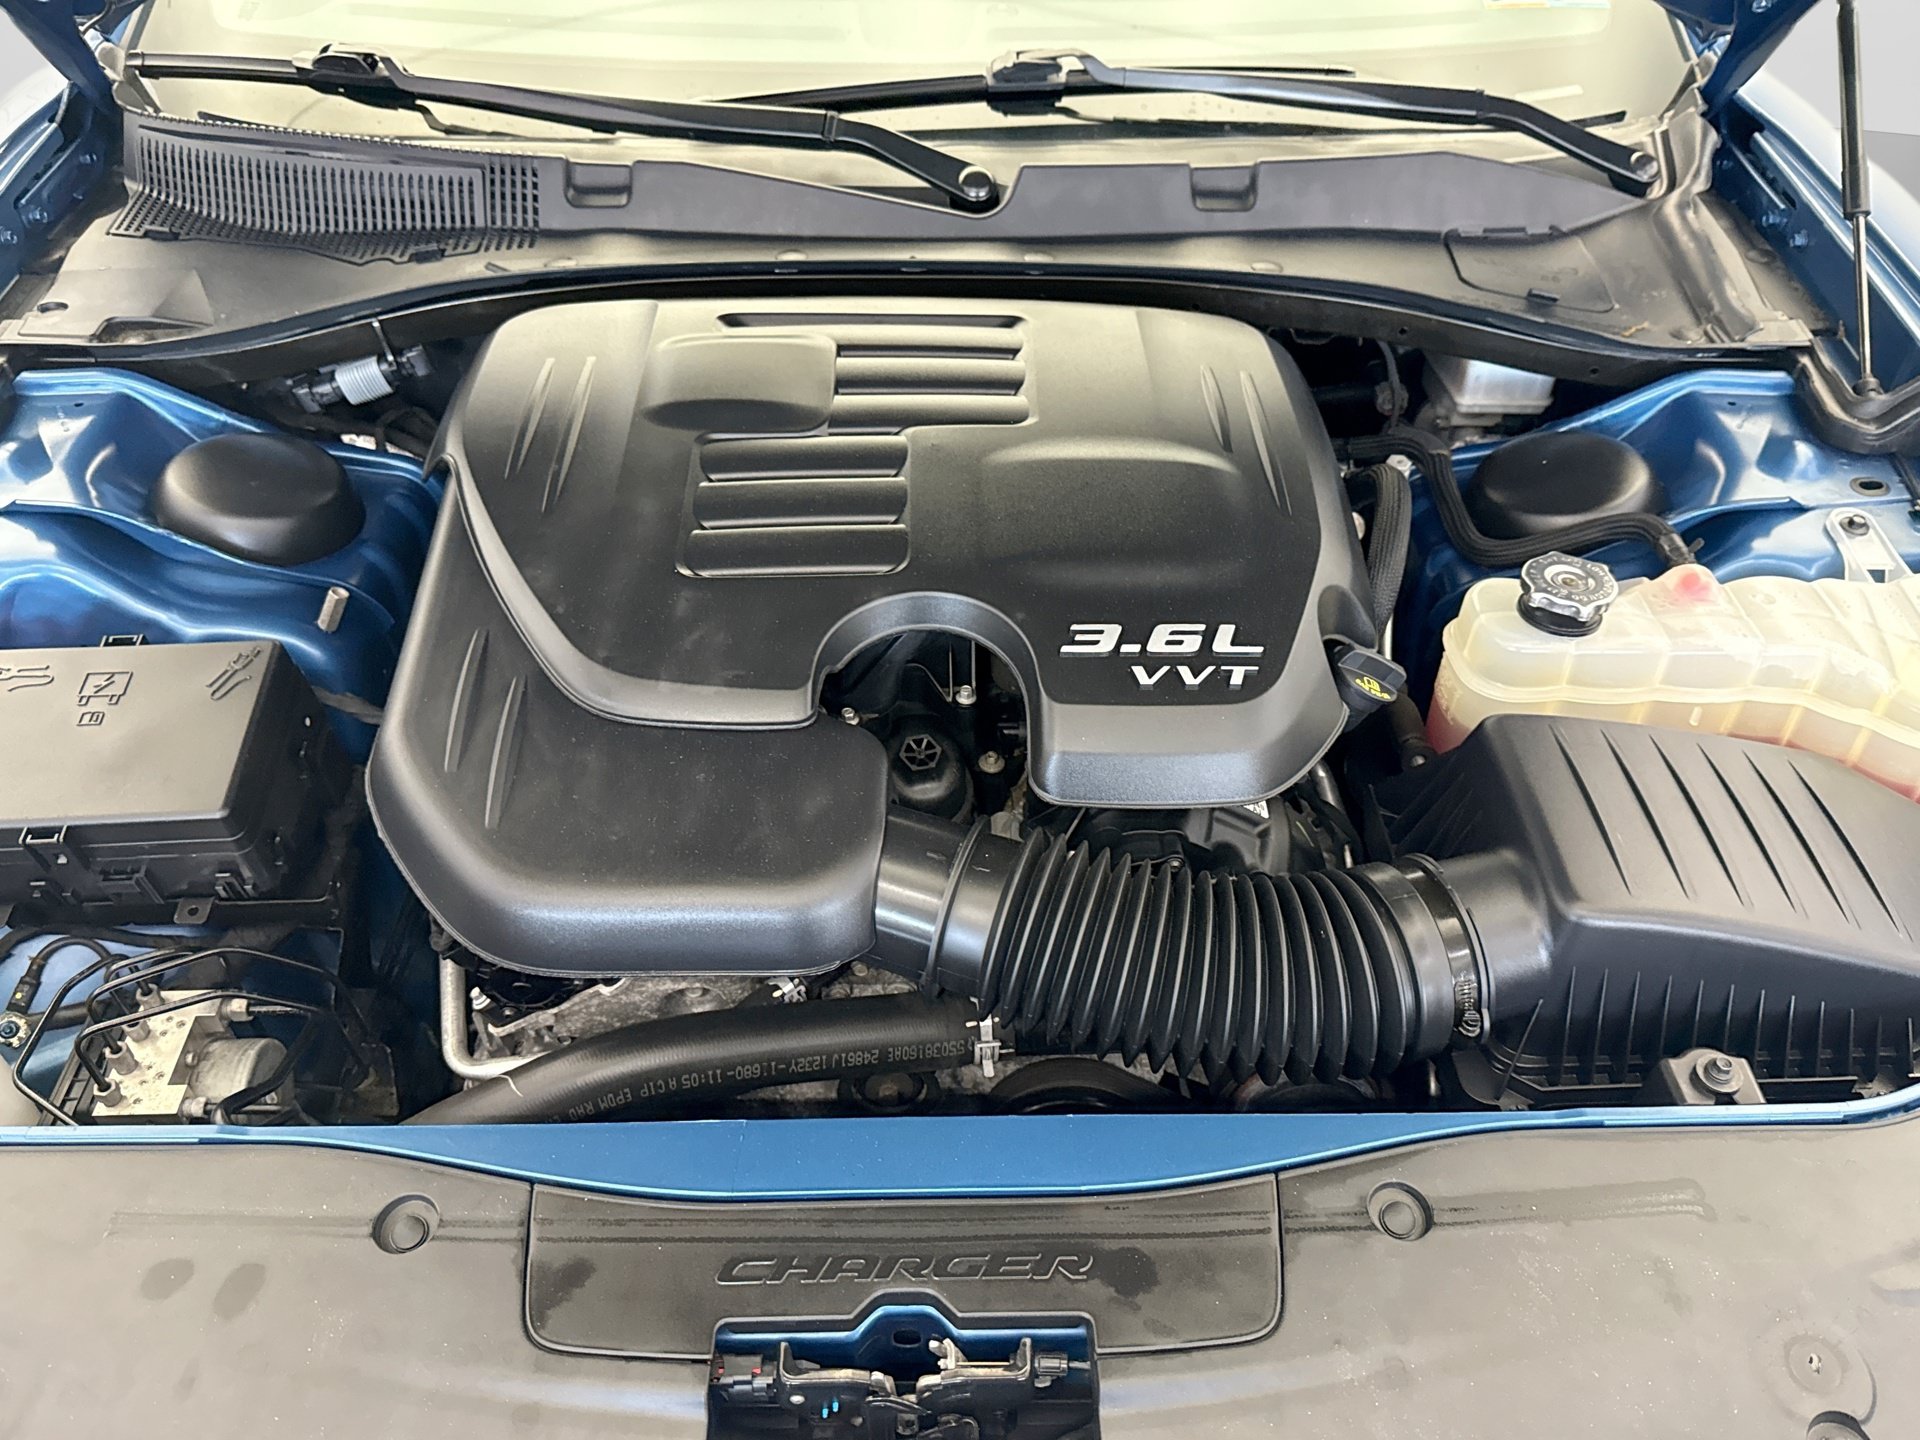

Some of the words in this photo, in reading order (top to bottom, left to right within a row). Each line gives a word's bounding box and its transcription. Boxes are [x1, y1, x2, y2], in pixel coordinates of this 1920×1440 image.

[1060, 623, 1264, 656] 3.6L
[1130, 665, 1259, 689] VVT
[599, 1088, 633, 1110] EPDM
[568, 1102, 595, 1121] RAD
[715, 1253, 1095, 1286] CHARGER
